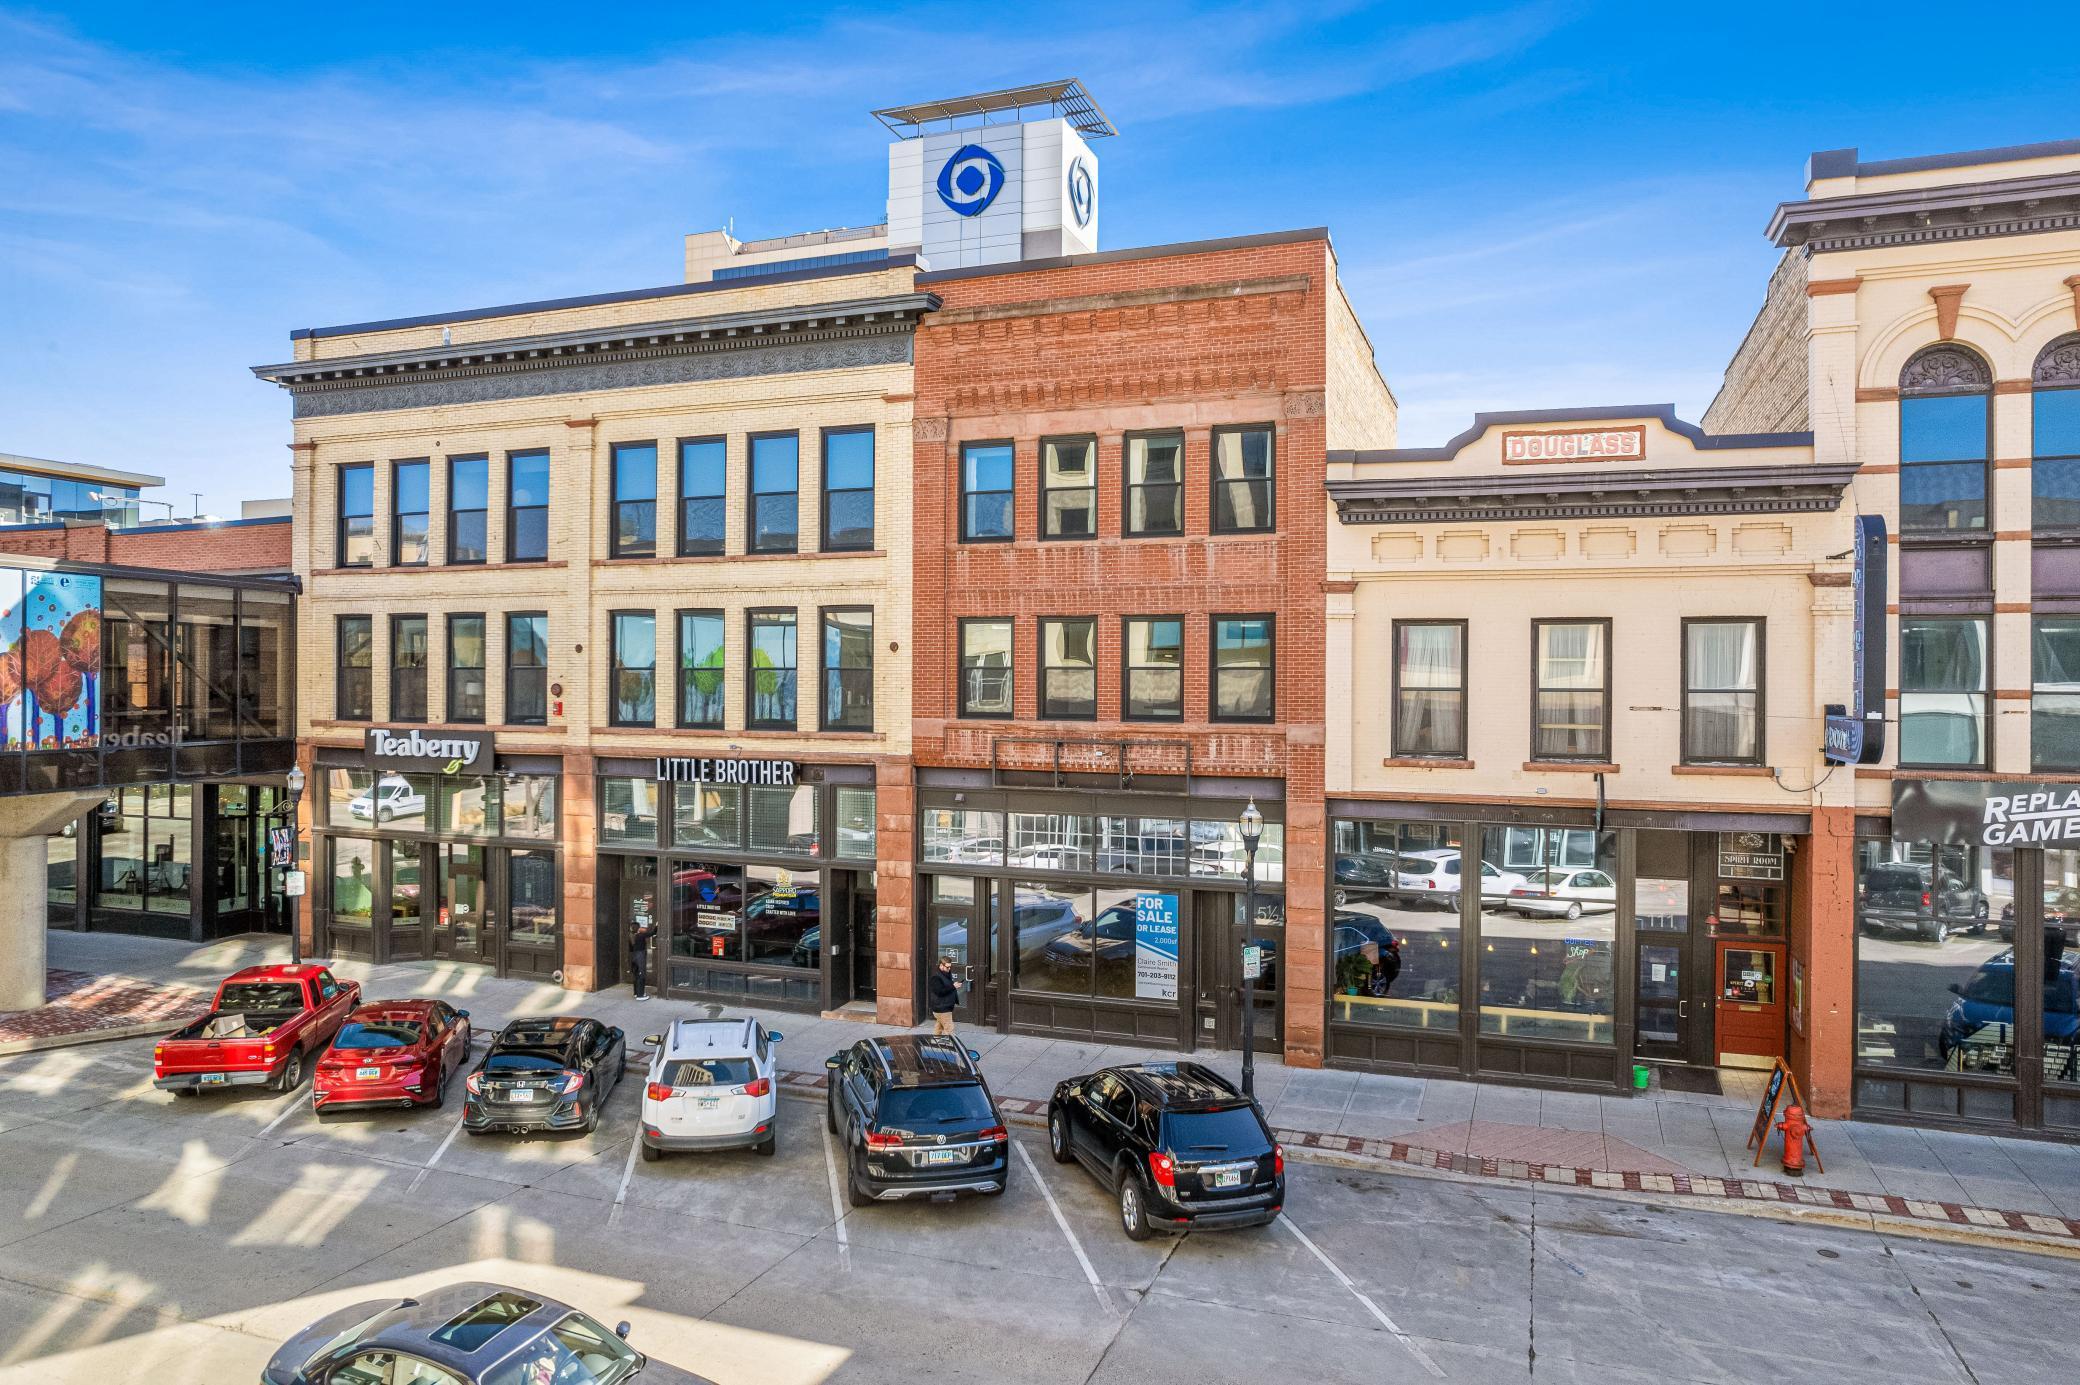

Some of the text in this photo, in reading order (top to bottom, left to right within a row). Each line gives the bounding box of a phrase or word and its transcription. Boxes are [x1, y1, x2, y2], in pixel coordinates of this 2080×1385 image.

[1511, 433, 1635, 457] DOUGLASS
[370, 729, 481, 765] Teaberry
[656, 757, 794, 785] LITTLE BROTHER
[1724, 855, 1777, 865] SPIRIT ROOM
[1137, 896, 1164, 910] FOR
[1137, 910, 1173, 923] SALE
[1137, 924, 1177, 934] OR LEASE
[1137, 957, 1177, 968] Claire Smith
[1161, 988, 1176, 998] kcr
